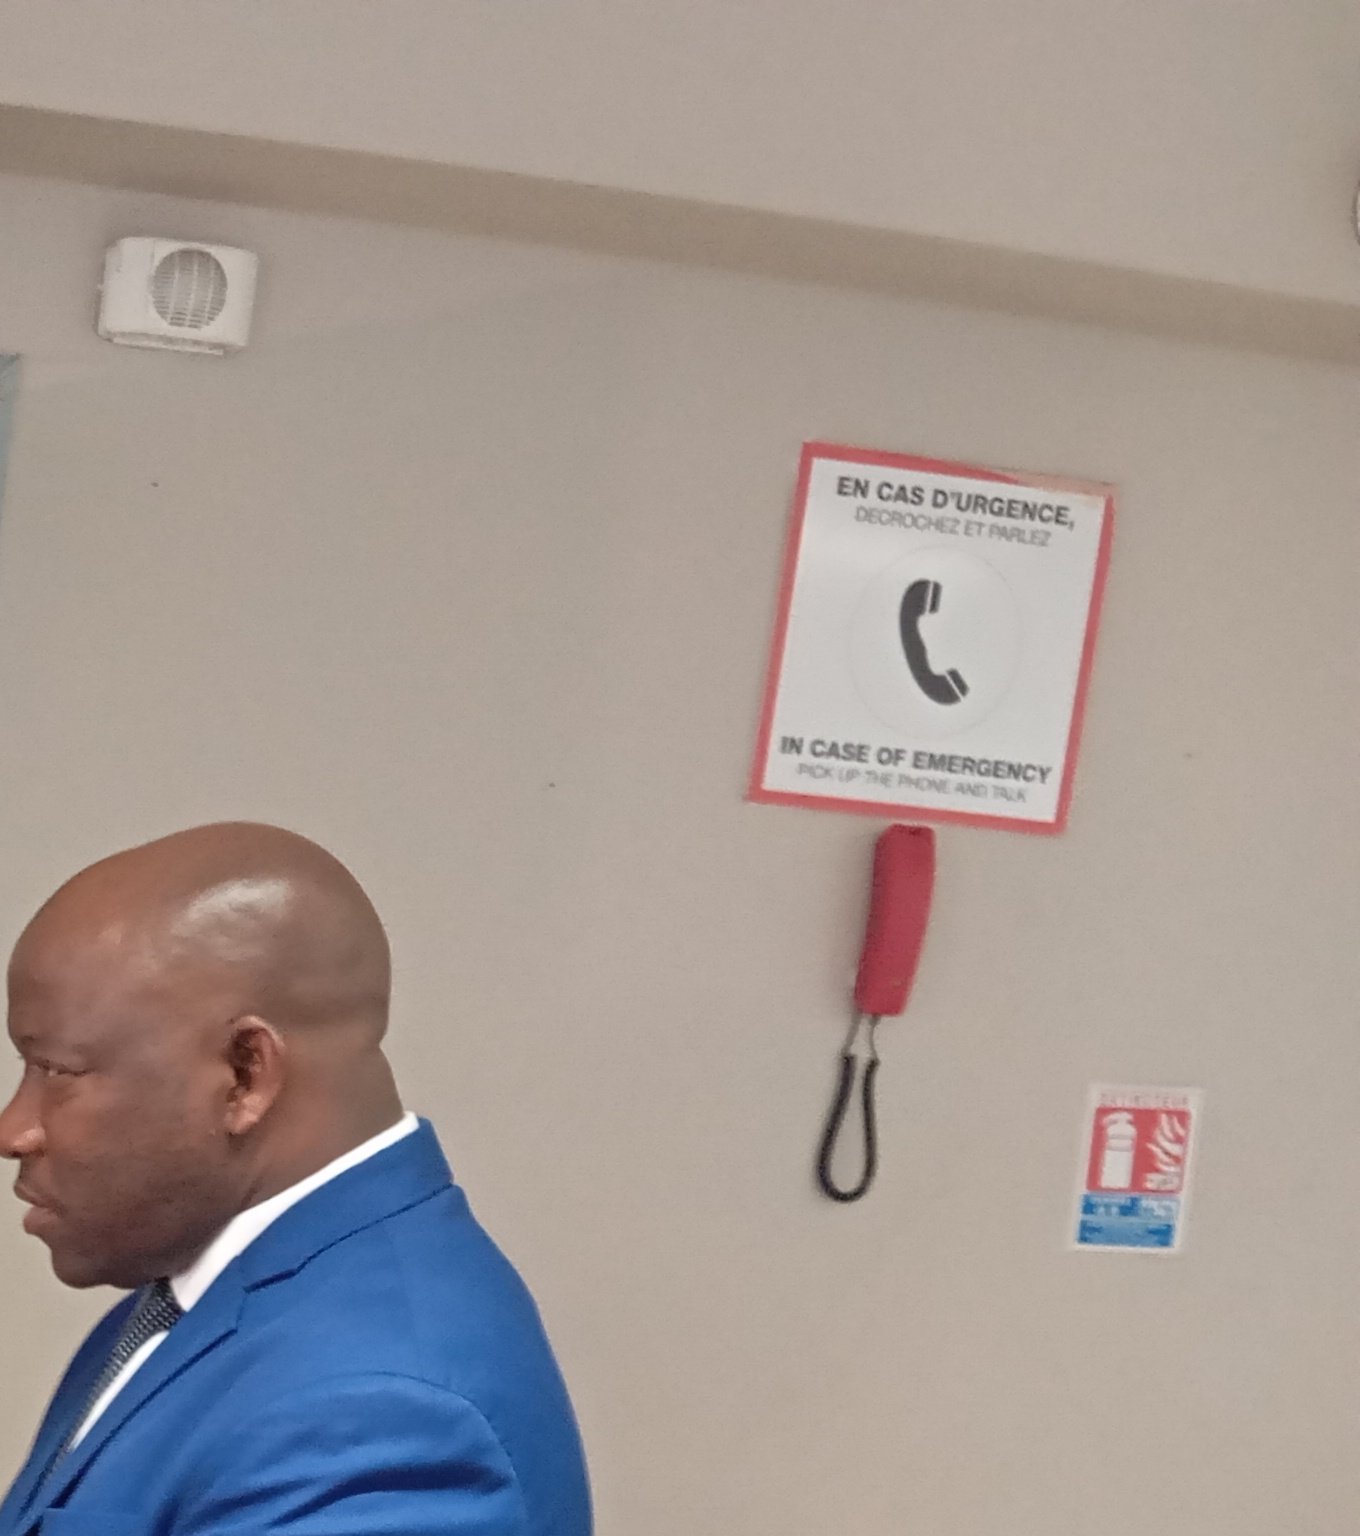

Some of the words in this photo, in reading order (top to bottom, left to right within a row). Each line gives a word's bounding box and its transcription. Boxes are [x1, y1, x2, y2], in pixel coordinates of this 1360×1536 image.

[836, 476, 870, 499] EN
[876, 482, 925, 506] CAS
[964, 521, 984, 538] ET
[988, 524, 1052, 547] PARLEZ
[780, 736, 804, 756] IN
[810, 740, 871, 764] CASE
[876, 747, 907, 766] OF
[911, 751, 1052, 784] EMERGENCY
[837, 768, 861, 783] UP
[865, 770, 893, 788] THE
[897, 774, 950, 795] PHONE
[954, 781, 989, 799] AND
